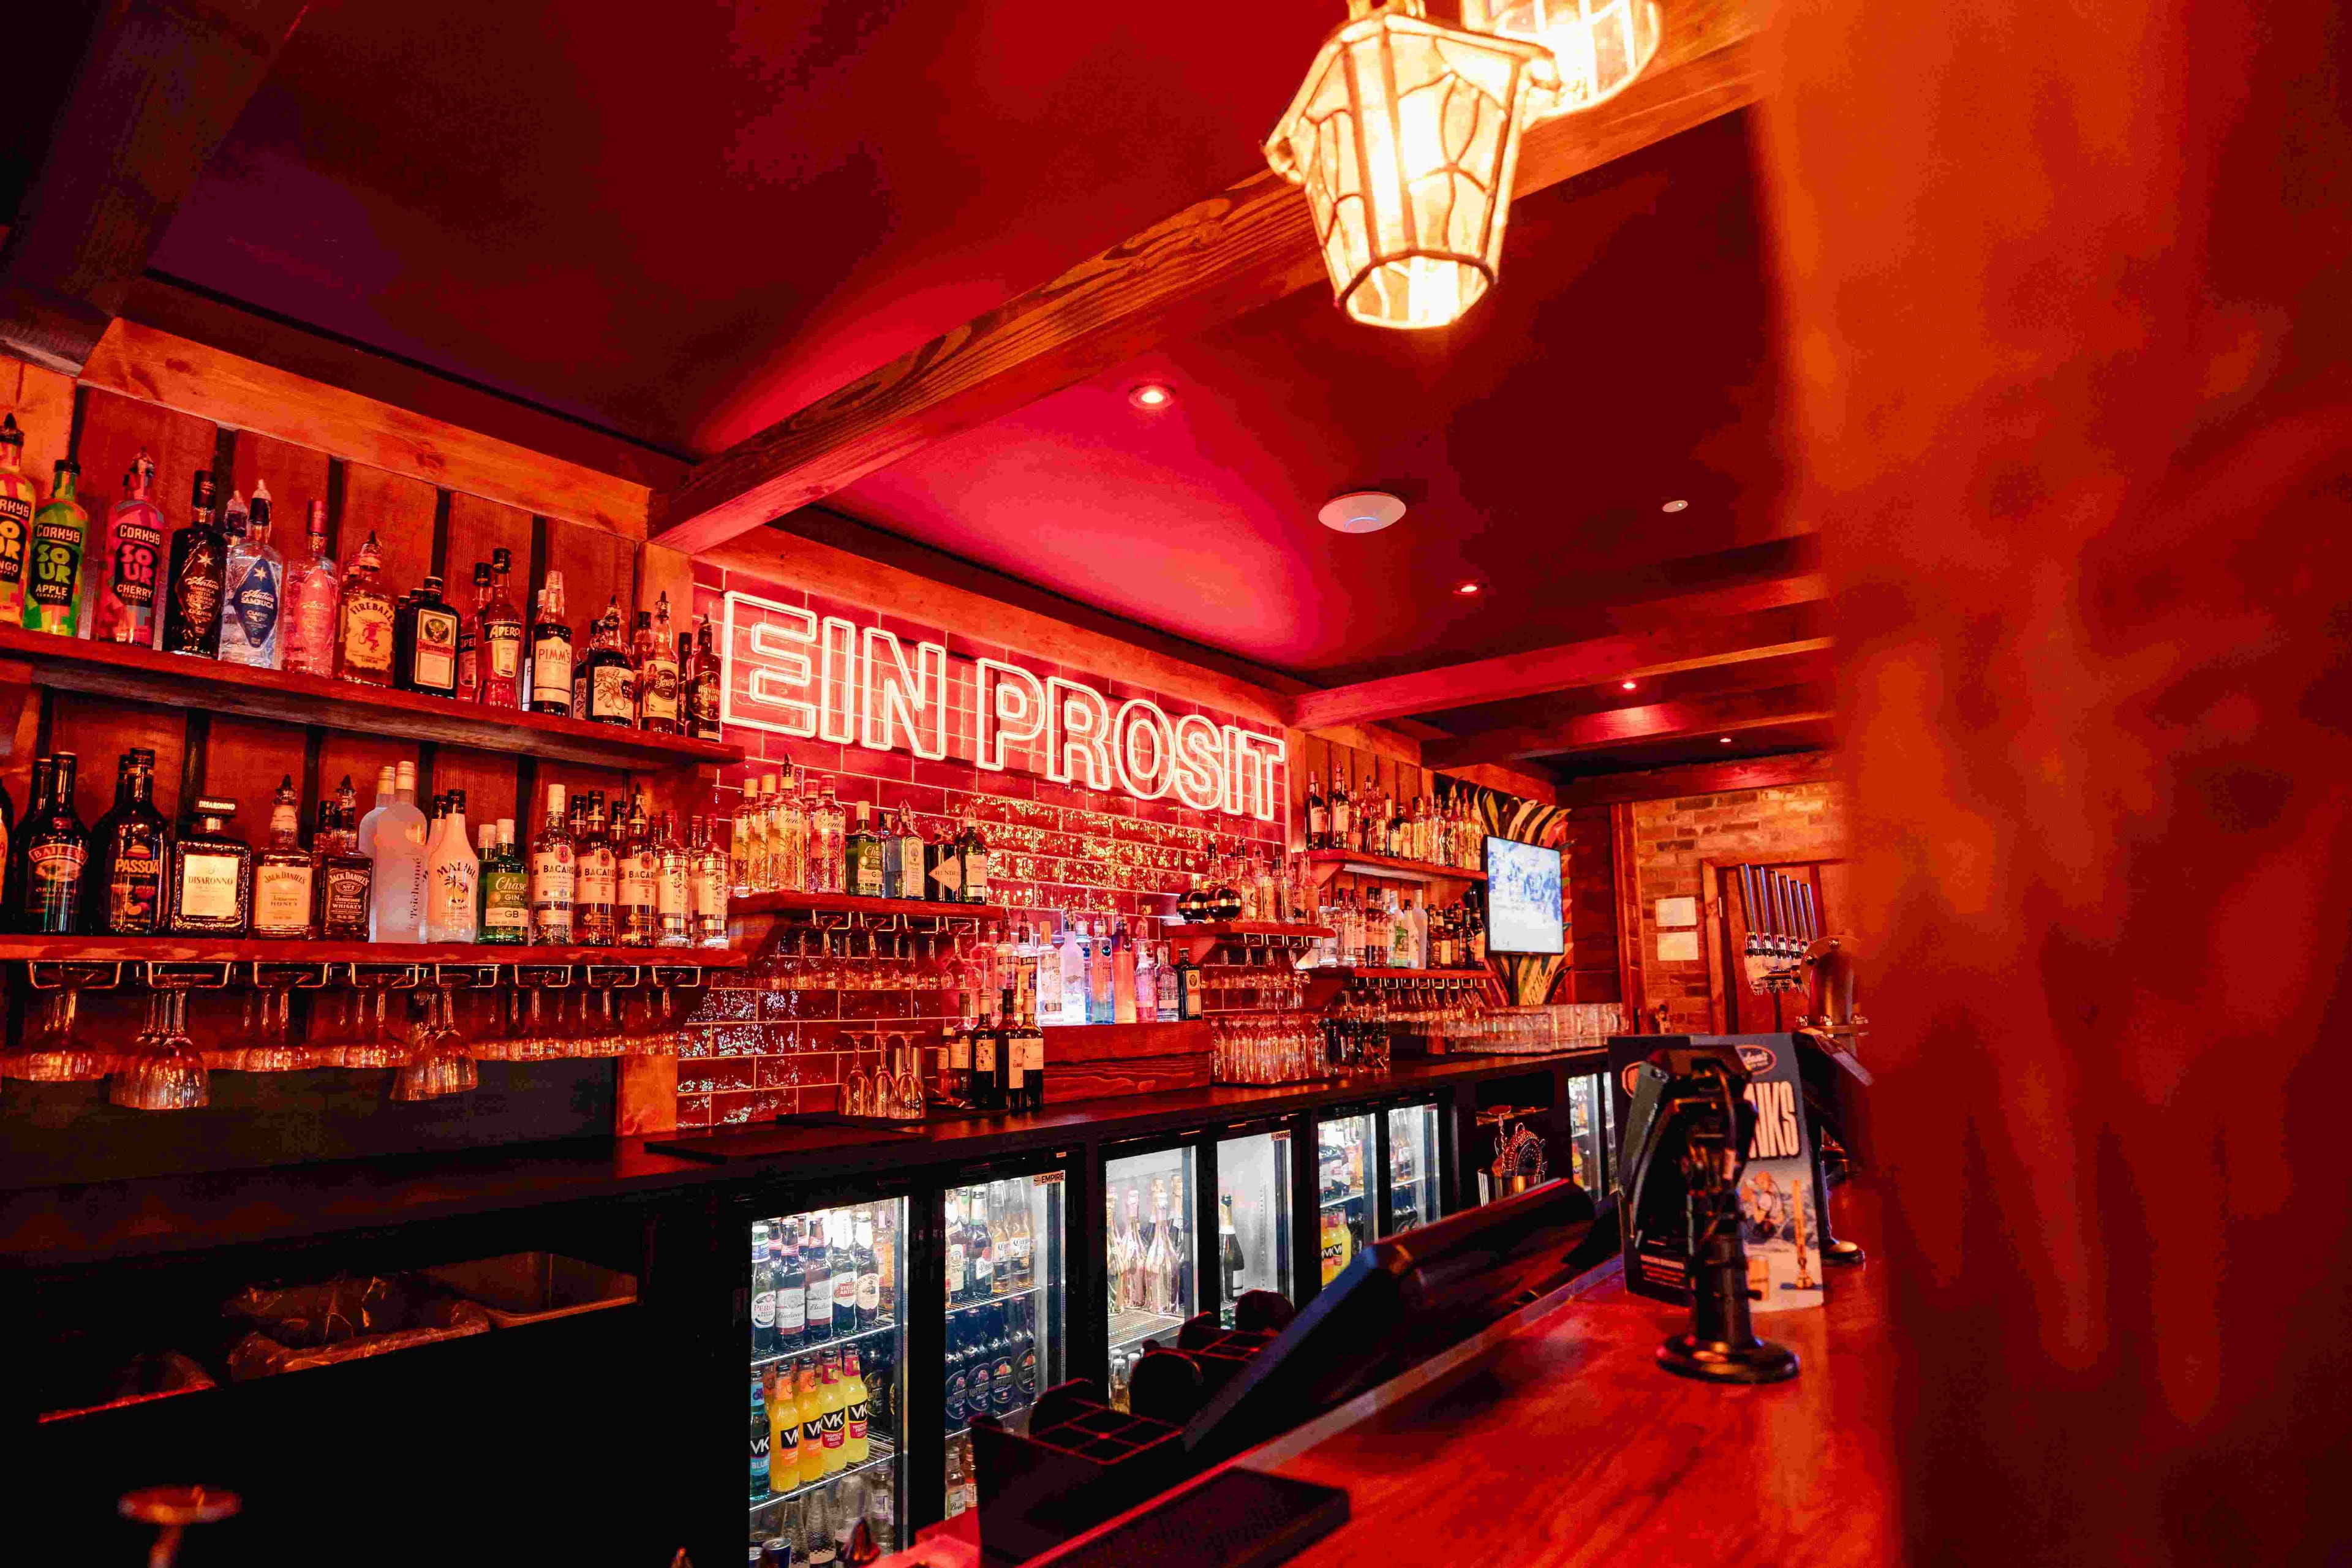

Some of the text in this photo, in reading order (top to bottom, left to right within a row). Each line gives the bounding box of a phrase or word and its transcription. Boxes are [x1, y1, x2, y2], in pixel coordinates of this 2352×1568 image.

[0, 559, 18, 573] NGO
[36, 584, 68, 597] APPLE
[117, 584, 153, 598] CHERRY
[241, 597, 274, 609] SAMBUCA
[350, 602, 393, 622] FIREBALL
[538, 648, 570, 663] PIMM'S
[704, 693, 718, 702] Club
[722, 590, 1285, 822] EIN PROSIT
[198, 801, 235, 810] DISARONNO
[34, 846, 85, 861] BAILEYS
[864, 845, 881, 856] Cha
[437, 862, 476, 880] MALIBU
[543, 865, 573, 873] BACARD
[188, 875, 233, 885] DISARONNO
[265, 870, 306, 884] JACK DANIEL'S
[329, 871, 369, 886] JACK DANIEL'S
[496, 876, 527, 891] Chase
[1041, 1172, 1064, 1183] EMPIRE
[850, 1401, 867, 1419] VK
[807, 1418, 823, 1436] VK
[823, 1412, 843, 1428] VK
[785, 1428, 799, 1446] VK
[750, 1436, 770, 1454] VK
